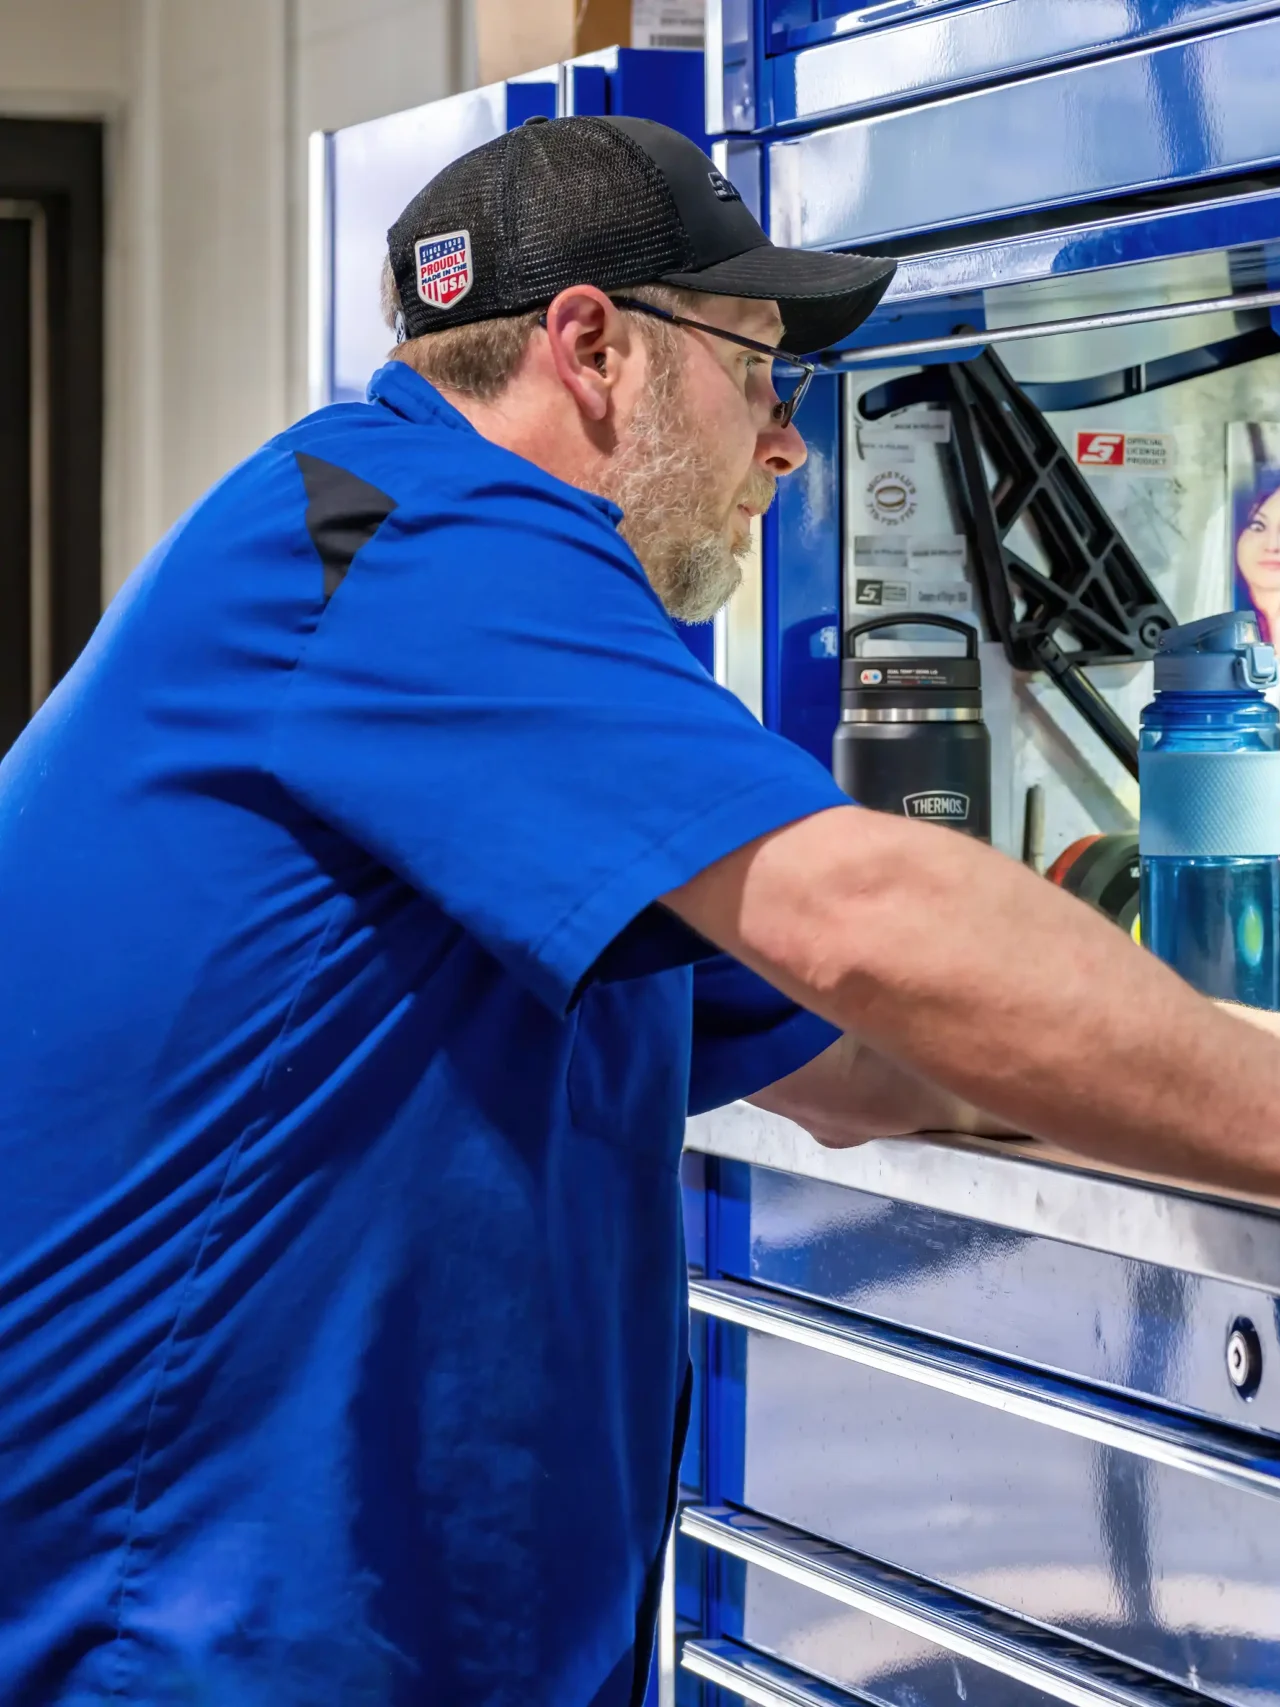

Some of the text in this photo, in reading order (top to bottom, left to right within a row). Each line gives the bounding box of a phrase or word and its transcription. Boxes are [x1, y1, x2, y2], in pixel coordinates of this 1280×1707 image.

[420, 250, 466, 278] PROUDLY
[421, 262, 467, 286] MADE IN THE
[440, 273, 466, 295] USA
[912, 797, 965, 815] THERMOS
